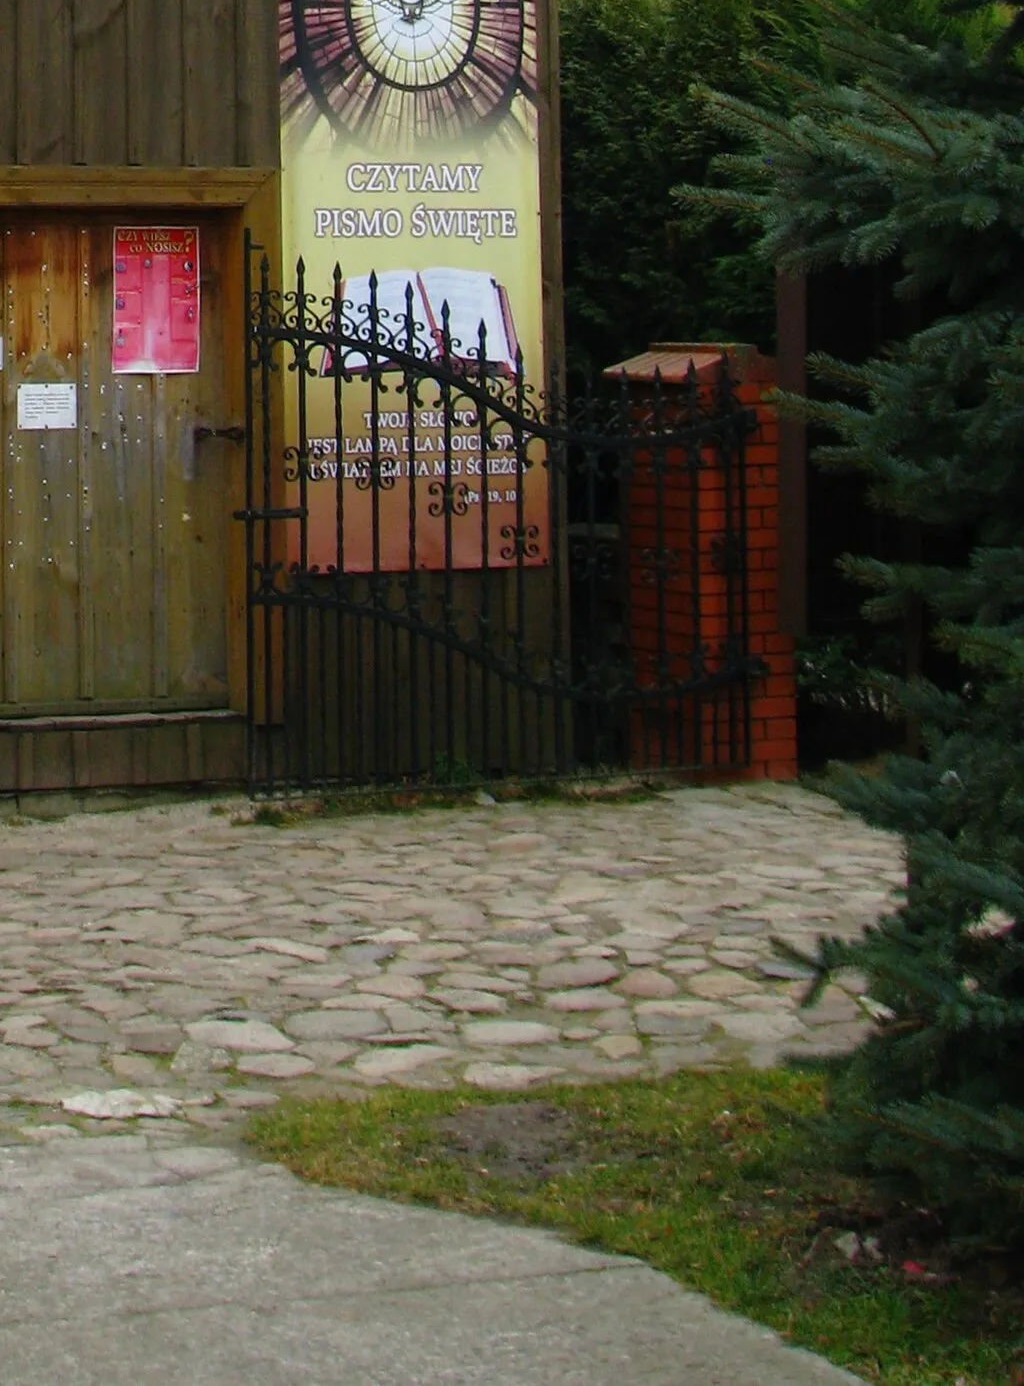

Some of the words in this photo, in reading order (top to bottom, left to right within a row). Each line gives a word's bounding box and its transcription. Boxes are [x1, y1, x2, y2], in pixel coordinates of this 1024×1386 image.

[346, 163, 483, 193] CZYTAMY
[117, 230, 137, 242] CZY
[314, 208, 403, 238] PISMO
[410, 202, 517, 245] ŚWIĘTE
[319, 460, 402, 479] ŚWIATEM
[466, 455, 527, 475] ŚCIEŻC
